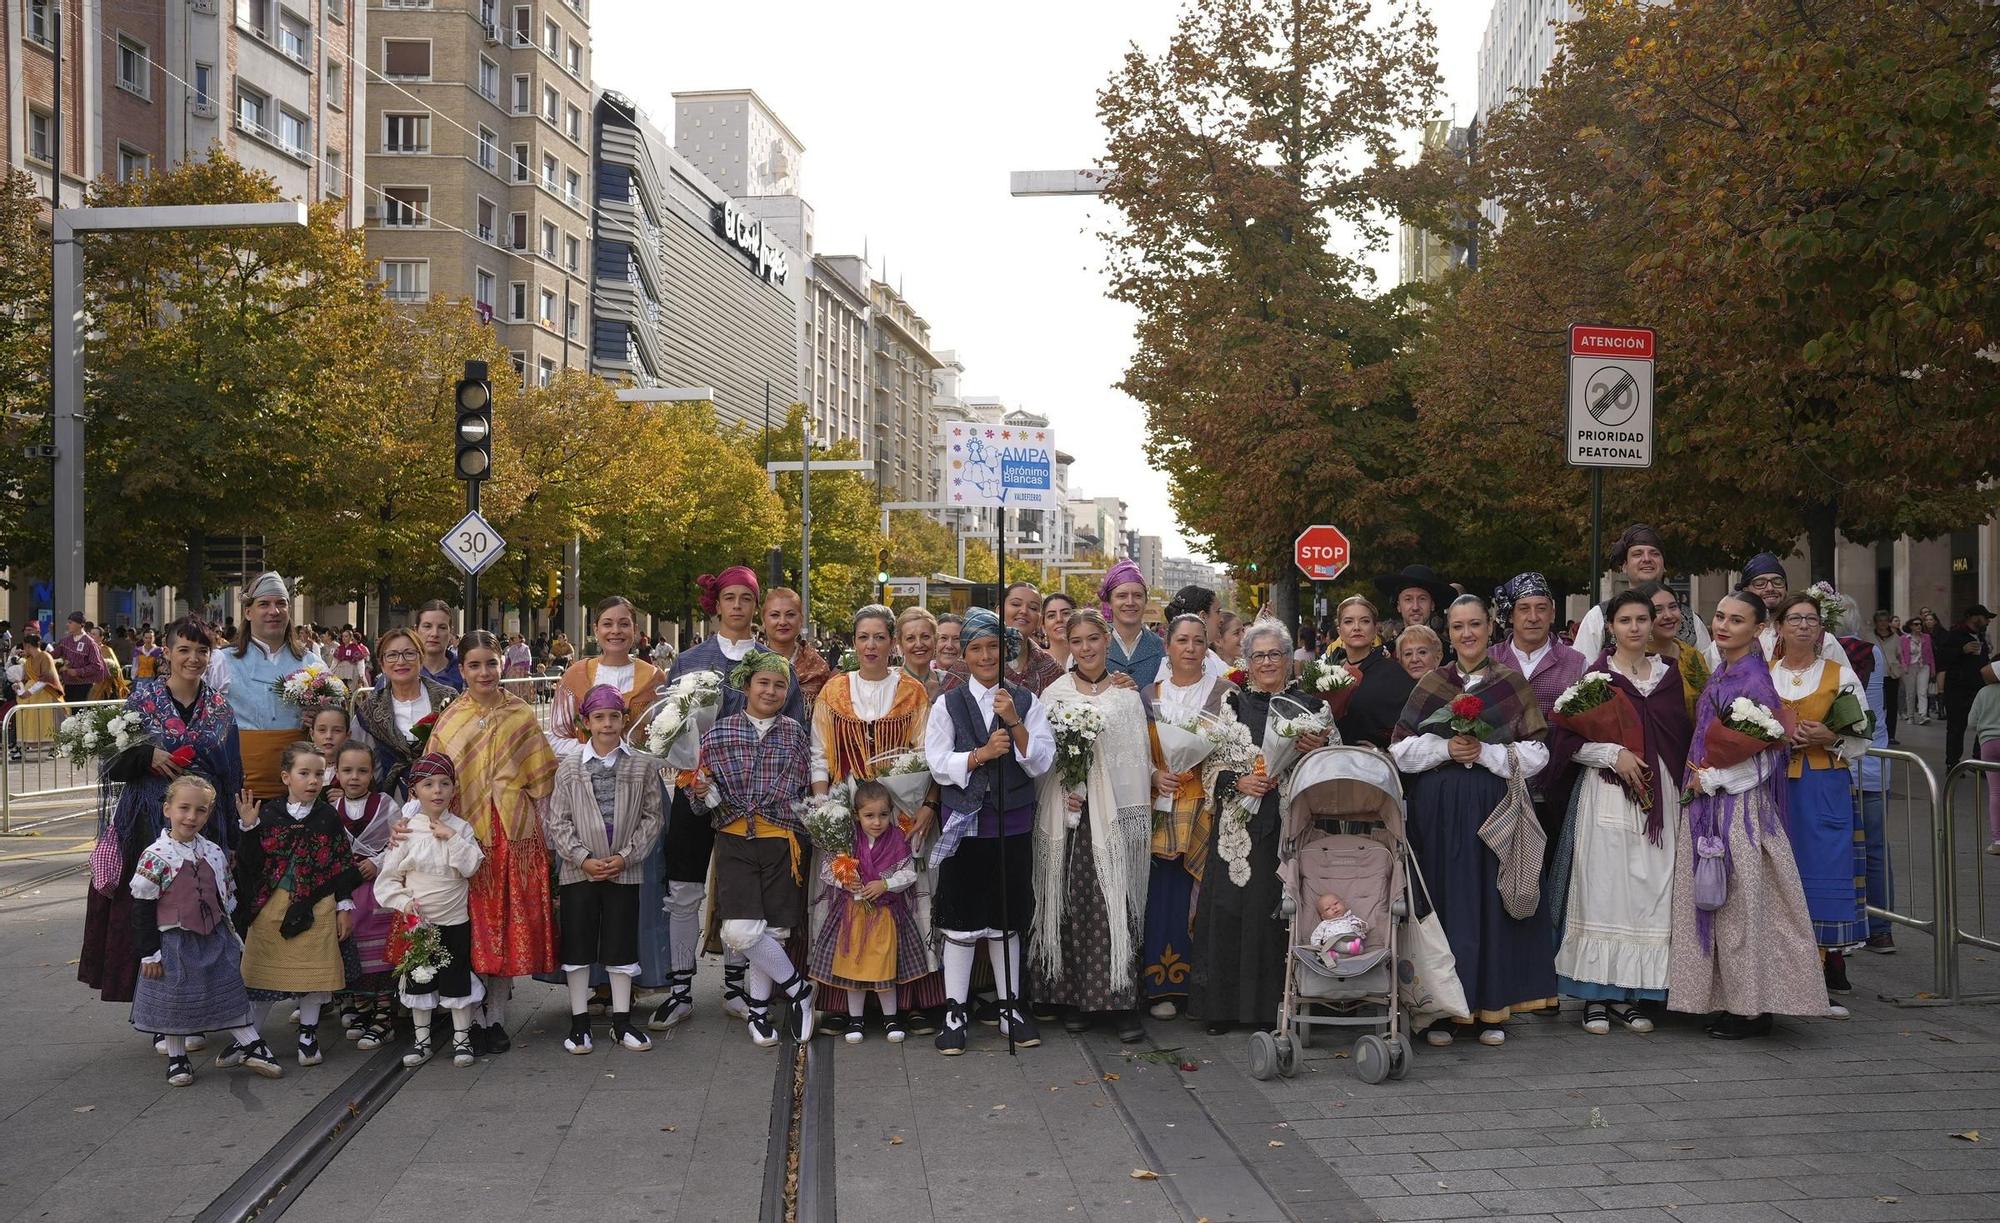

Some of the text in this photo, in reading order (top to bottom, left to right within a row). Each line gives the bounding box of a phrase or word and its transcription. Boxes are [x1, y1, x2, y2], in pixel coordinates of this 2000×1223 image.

[1581, 336, 1645, 349] ATENCIÓN
[1578, 431, 1644, 443] PRIORIDAD
[1002, 447, 1049, 463] AMPA
[1578, 447, 1643, 459] PEATONAL
[1003, 465, 1049, 478] Jerónimo
[1004, 474, 1043, 485] Blancas
[459, 532, 487, 553] 30
[1301, 546, 1344, 559] STOP
